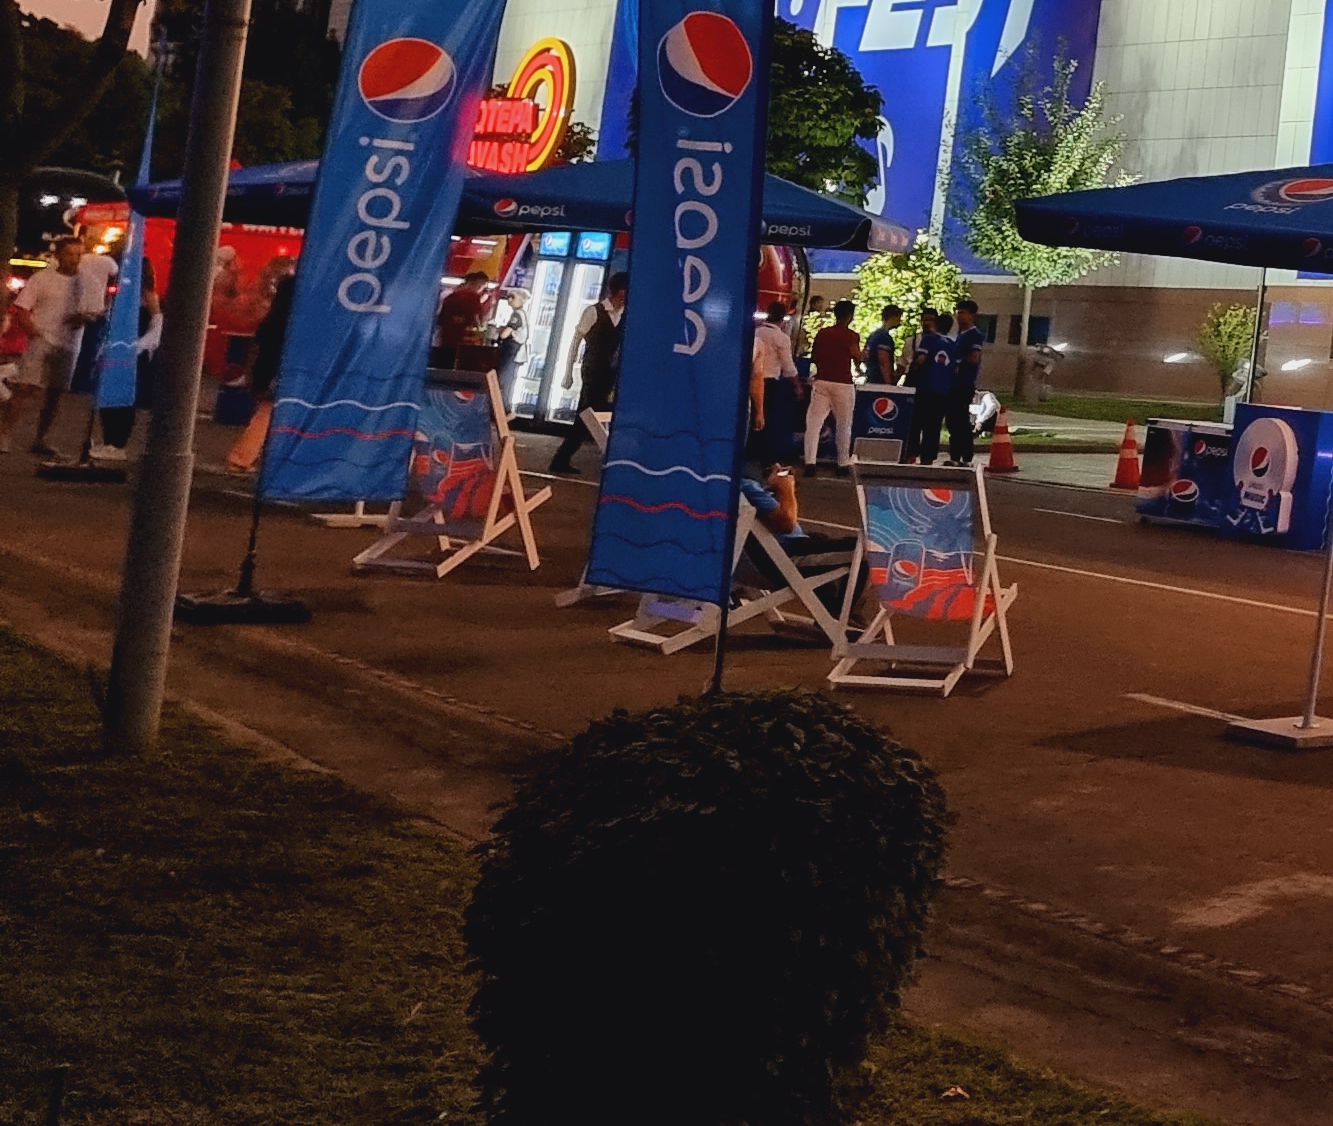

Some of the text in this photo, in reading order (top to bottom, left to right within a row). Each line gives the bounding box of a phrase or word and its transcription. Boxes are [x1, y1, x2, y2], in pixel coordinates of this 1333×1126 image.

[518, 204, 566, 217] pepsi
[337, 136, 415, 313] pepsi
[767, 224, 812, 237] pepsi
